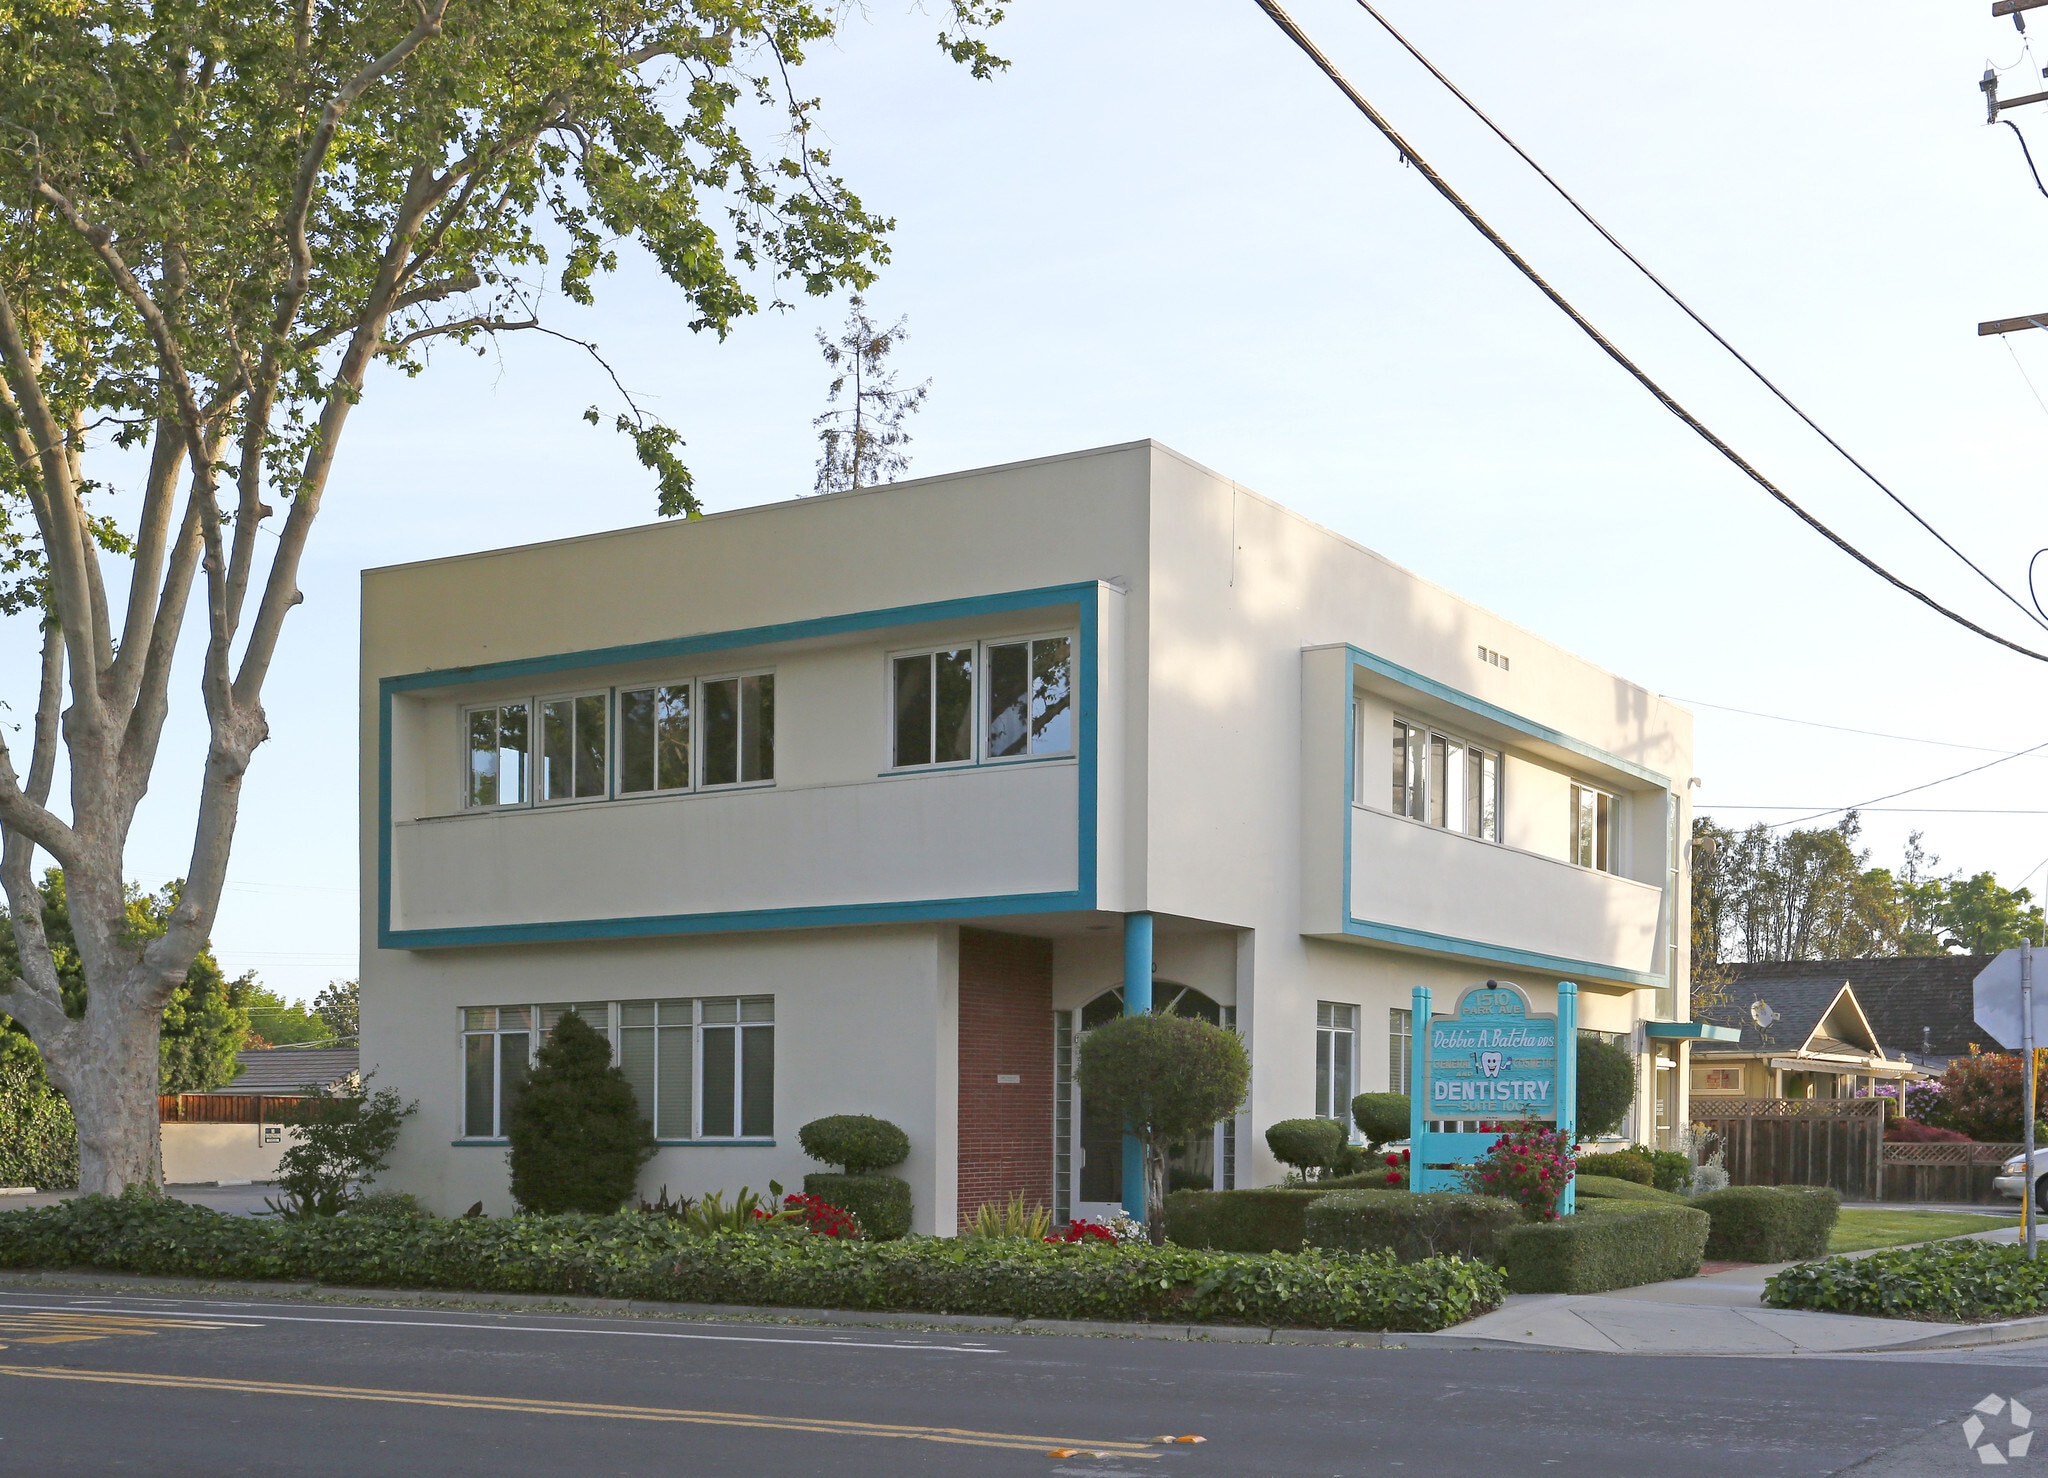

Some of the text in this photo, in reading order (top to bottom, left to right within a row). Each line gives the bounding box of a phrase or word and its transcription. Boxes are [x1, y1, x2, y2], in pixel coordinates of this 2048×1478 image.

[1476, 992, 1510, 1007] 1510
[1462, 1005, 1521, 1015] PARK AVE
[1434, 1029, 1476, 1048] Debbie
[1491, 1028, 1535, 1048] Batcha
[1433, 1059, 1472, 1069] GENERAL
[1434, 1081, 1550, 1101] DENTISTRY
[1460, 1101, 1497, 1112] SUITE
